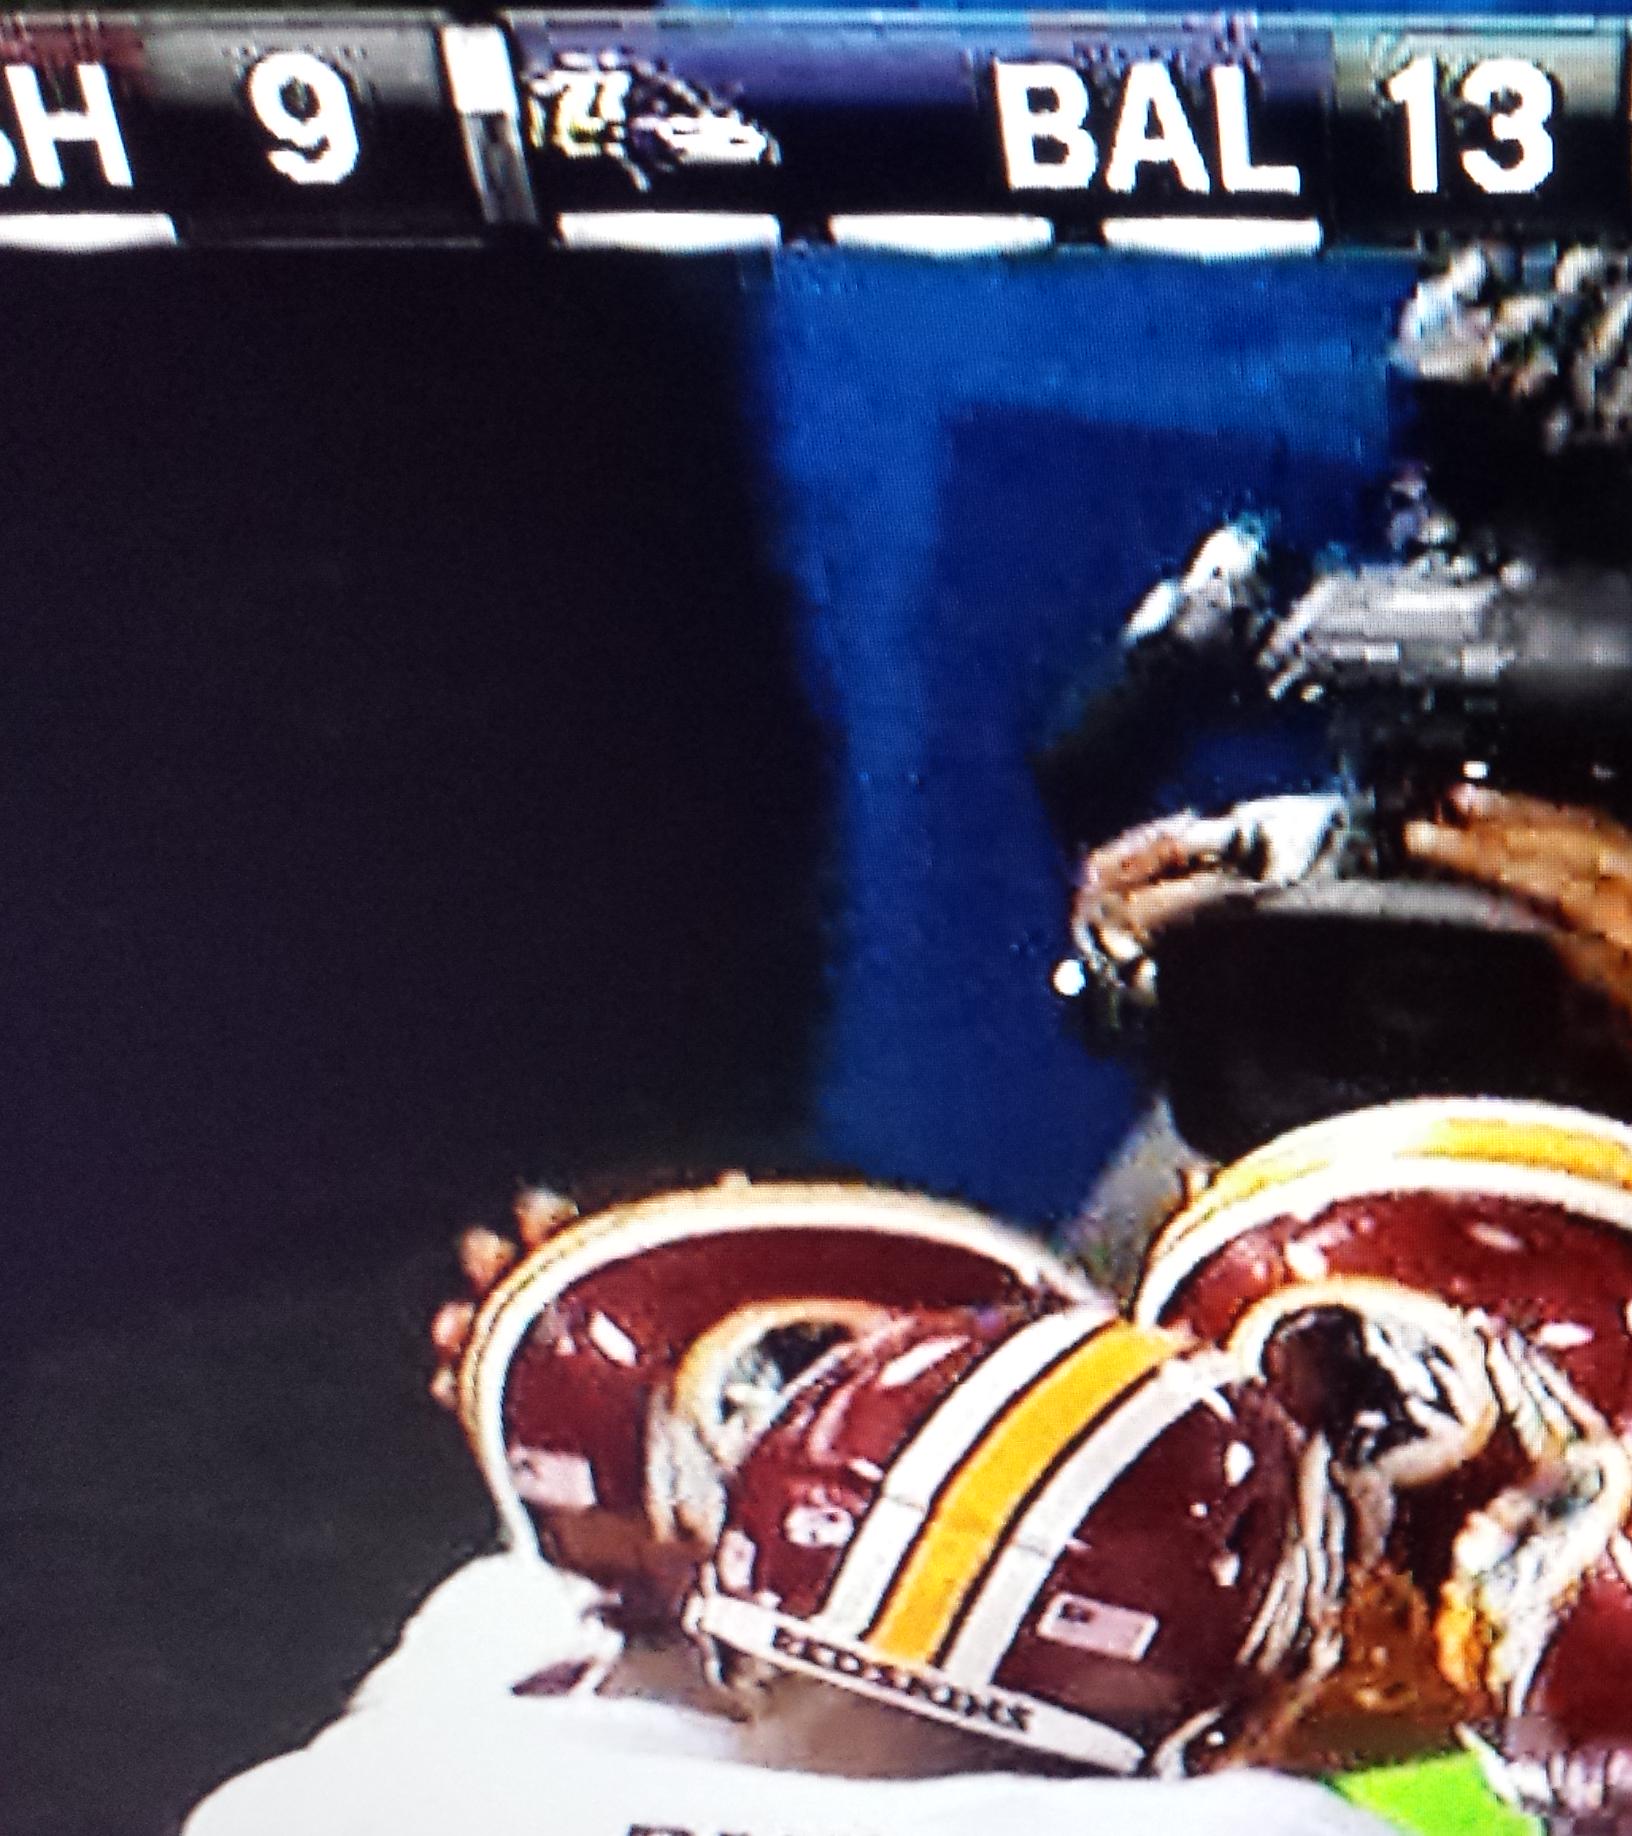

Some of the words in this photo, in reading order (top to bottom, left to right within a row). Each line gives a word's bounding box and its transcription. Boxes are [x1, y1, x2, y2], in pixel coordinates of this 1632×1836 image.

[249, 50, 361, 184] 9
[994, 60, 1302, 194] BAL
[1389, 57, 1555, 194] 13
